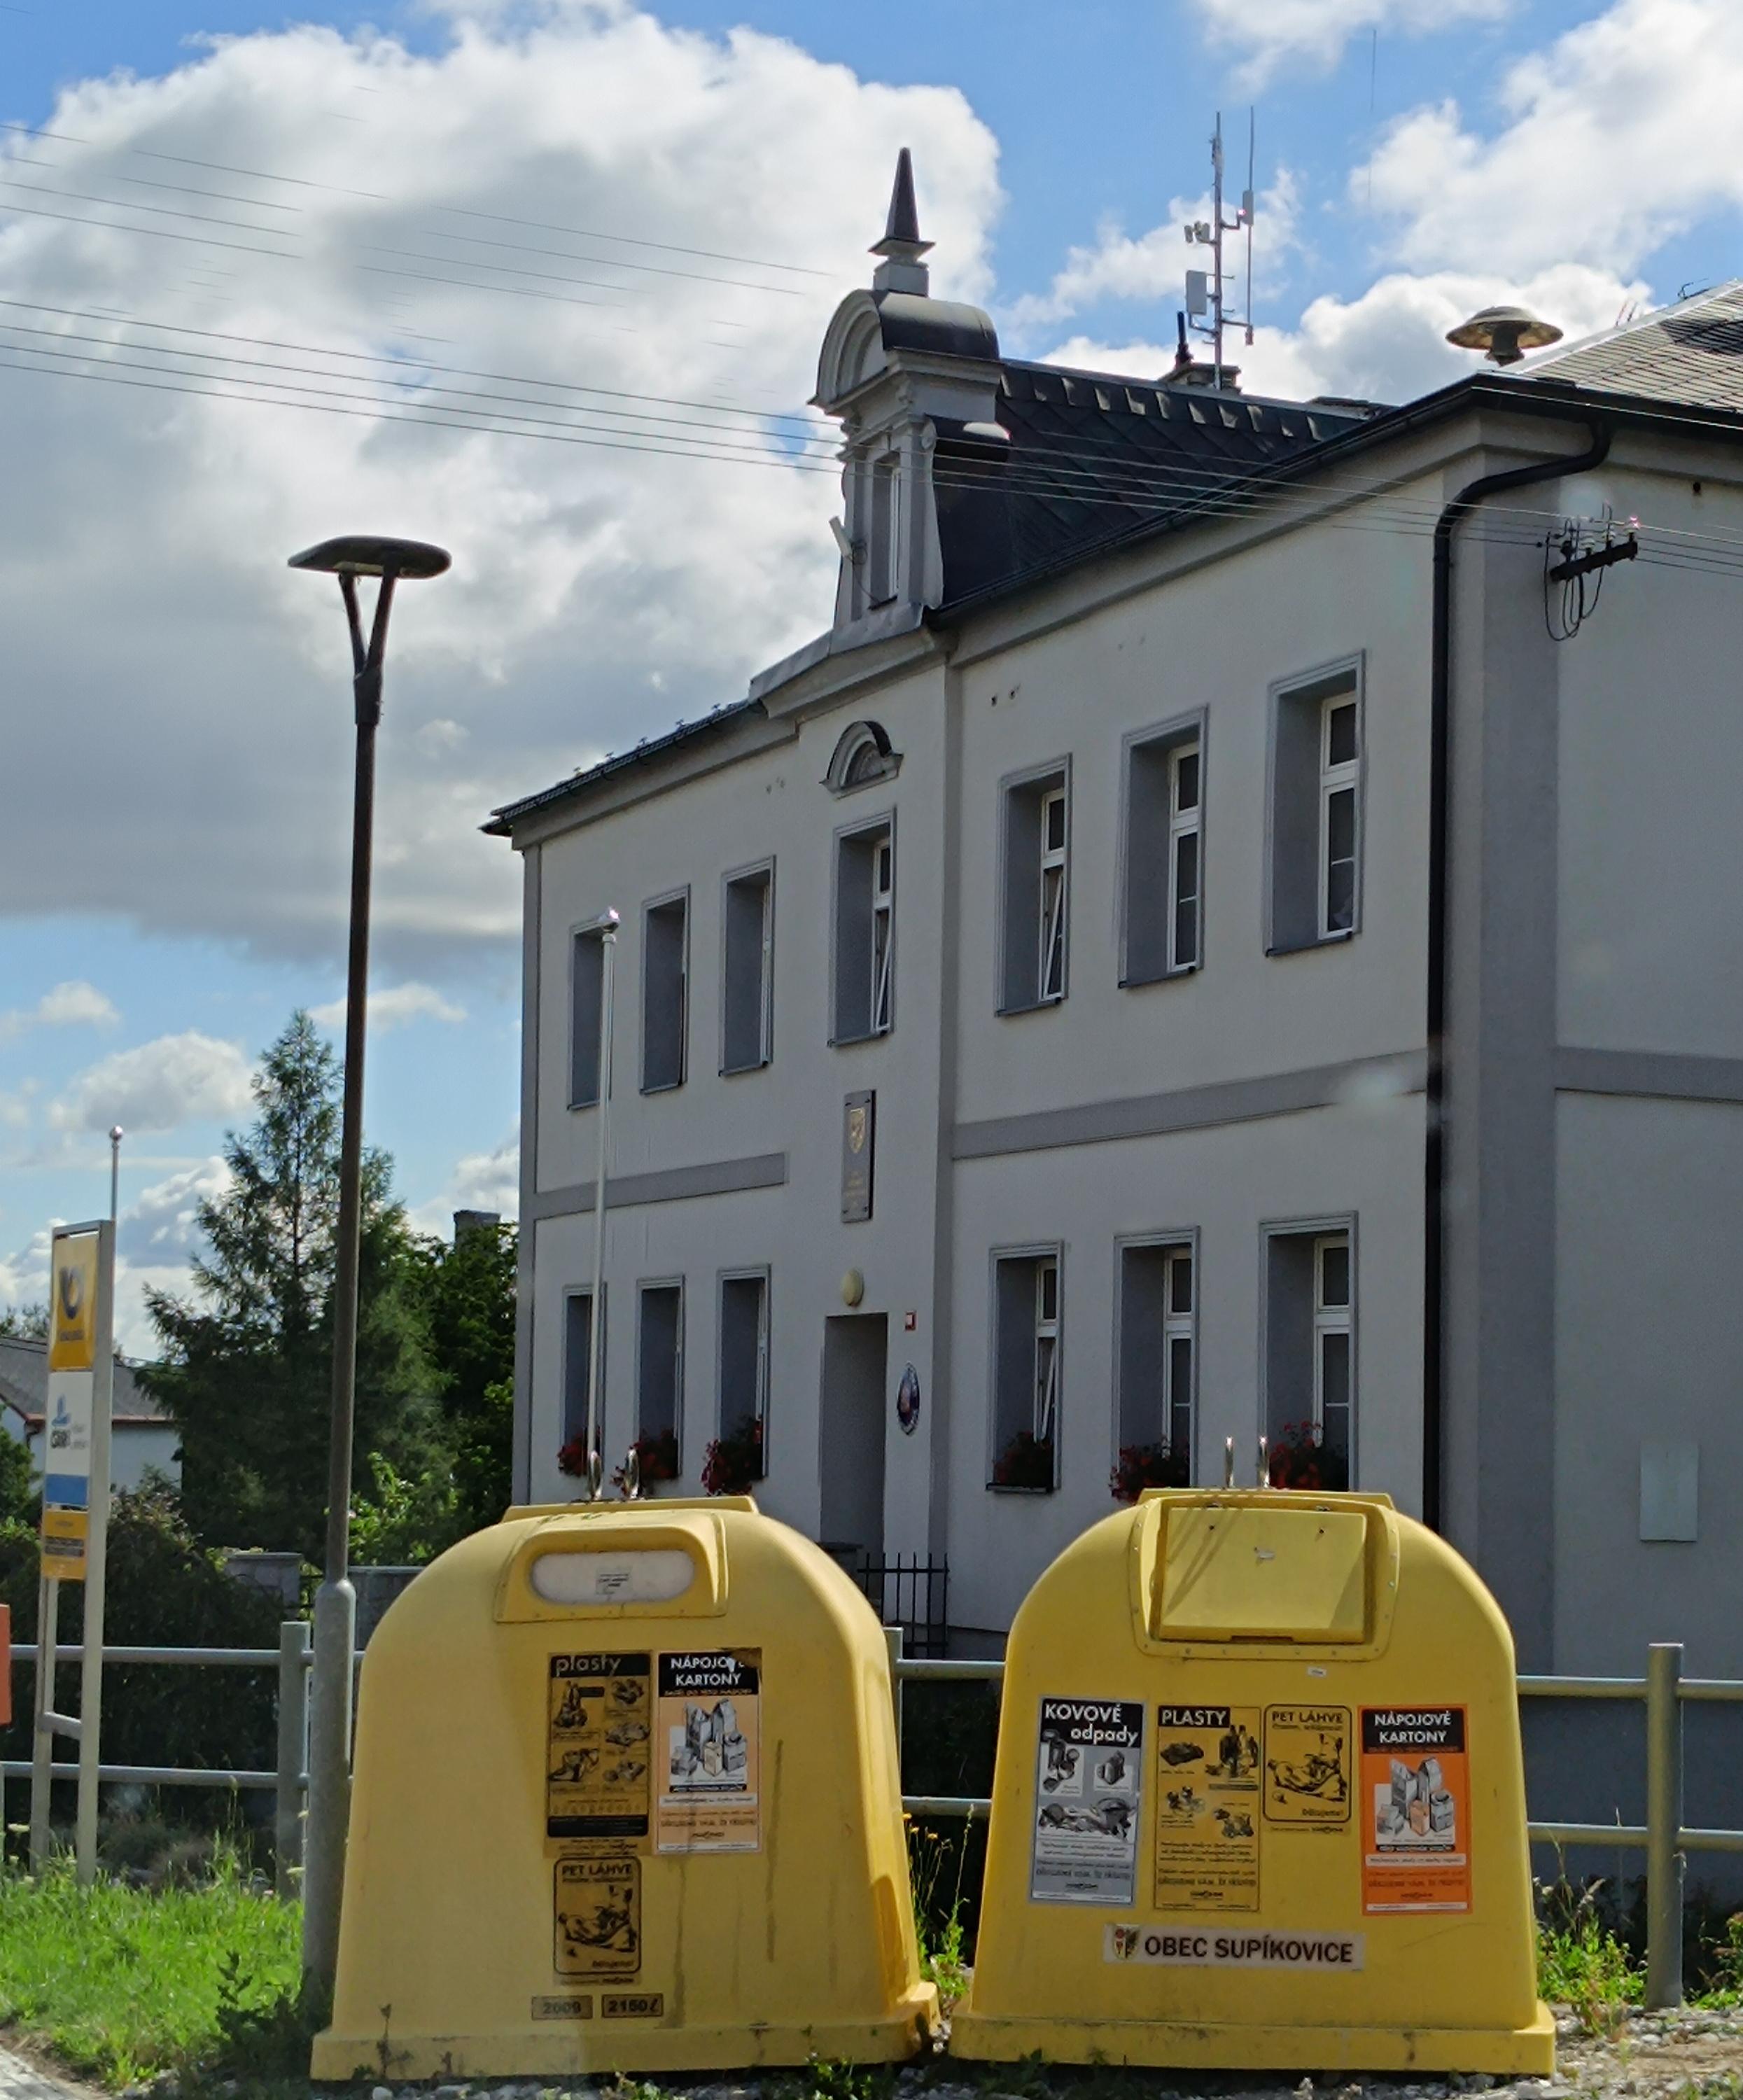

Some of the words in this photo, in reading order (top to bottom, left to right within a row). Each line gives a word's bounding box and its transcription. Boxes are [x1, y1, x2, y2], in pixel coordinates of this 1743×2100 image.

[556, 1654, 622, 1676] plasty
[671, 1656, 745, 1670] NÁPOJO
[676, 1673, 742, 1686] KARTONY
[1044, 1704, 1123, 1723] KOVOVÉ
[1162, 1709, 1228, 1726] PLASTY
[1272, 1710, 1294, 1722] PET
[1299, 1709, 1343, 1723] LÁHVE
[1373, 1710, 1451, 1727] NÁPOJOVÉ
[1070, 1723, 1139, 1747] odpady
[1379, 1730, 1447, 1744] KARTONY
[562, 1864, 584, 1876] PET
[589, 1861, 632, 1875] LÁHVE
[1144, 1936, 1208, 1958] OBEC
[1214, 1933, 1353, 1963] SUPÍKOVICE
